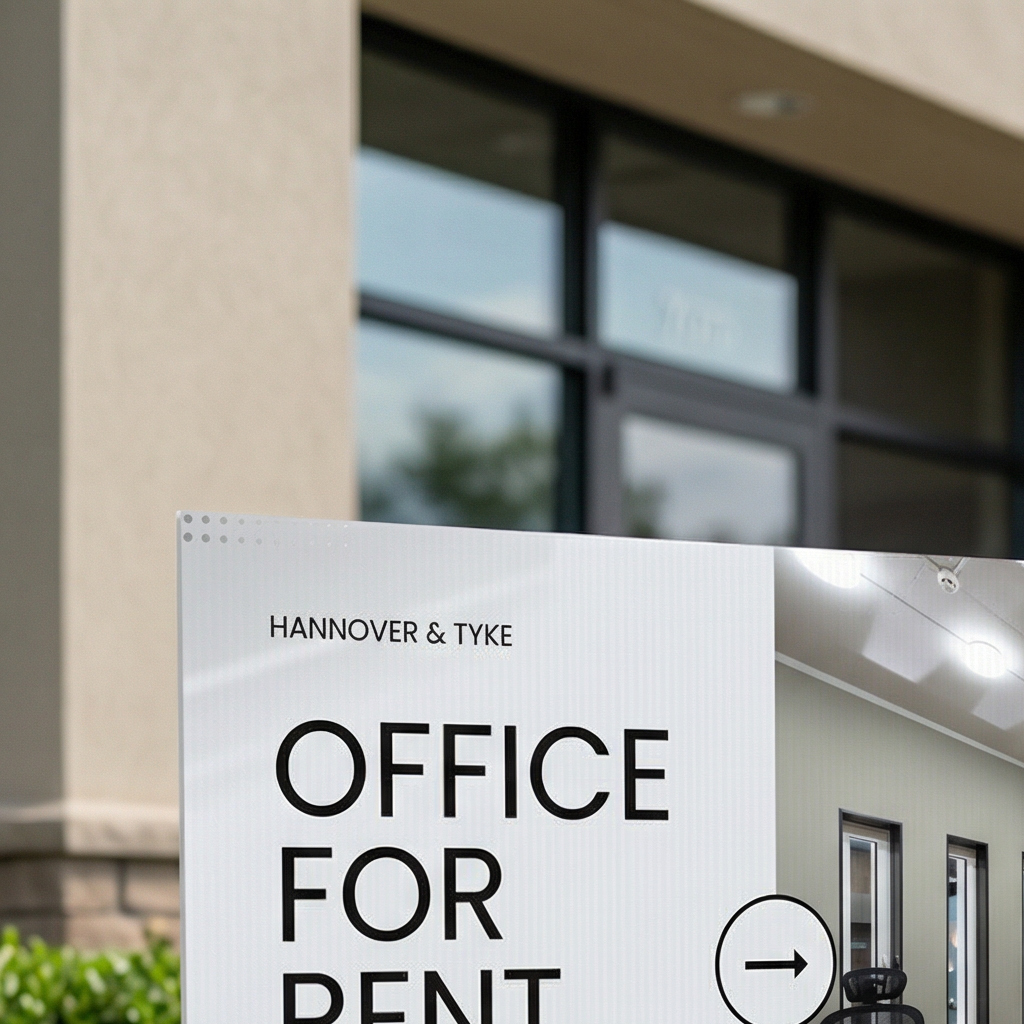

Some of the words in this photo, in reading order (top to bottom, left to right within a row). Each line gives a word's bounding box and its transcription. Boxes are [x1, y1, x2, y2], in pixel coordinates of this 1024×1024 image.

[270, 614, 418, 644] HANNOVER
[426, 621, 447, 645] &
[453, 622, 513, 647] TYKE
[275, 719, 669, 821] OFFICE
[281, 846, 504, 943] FOR
